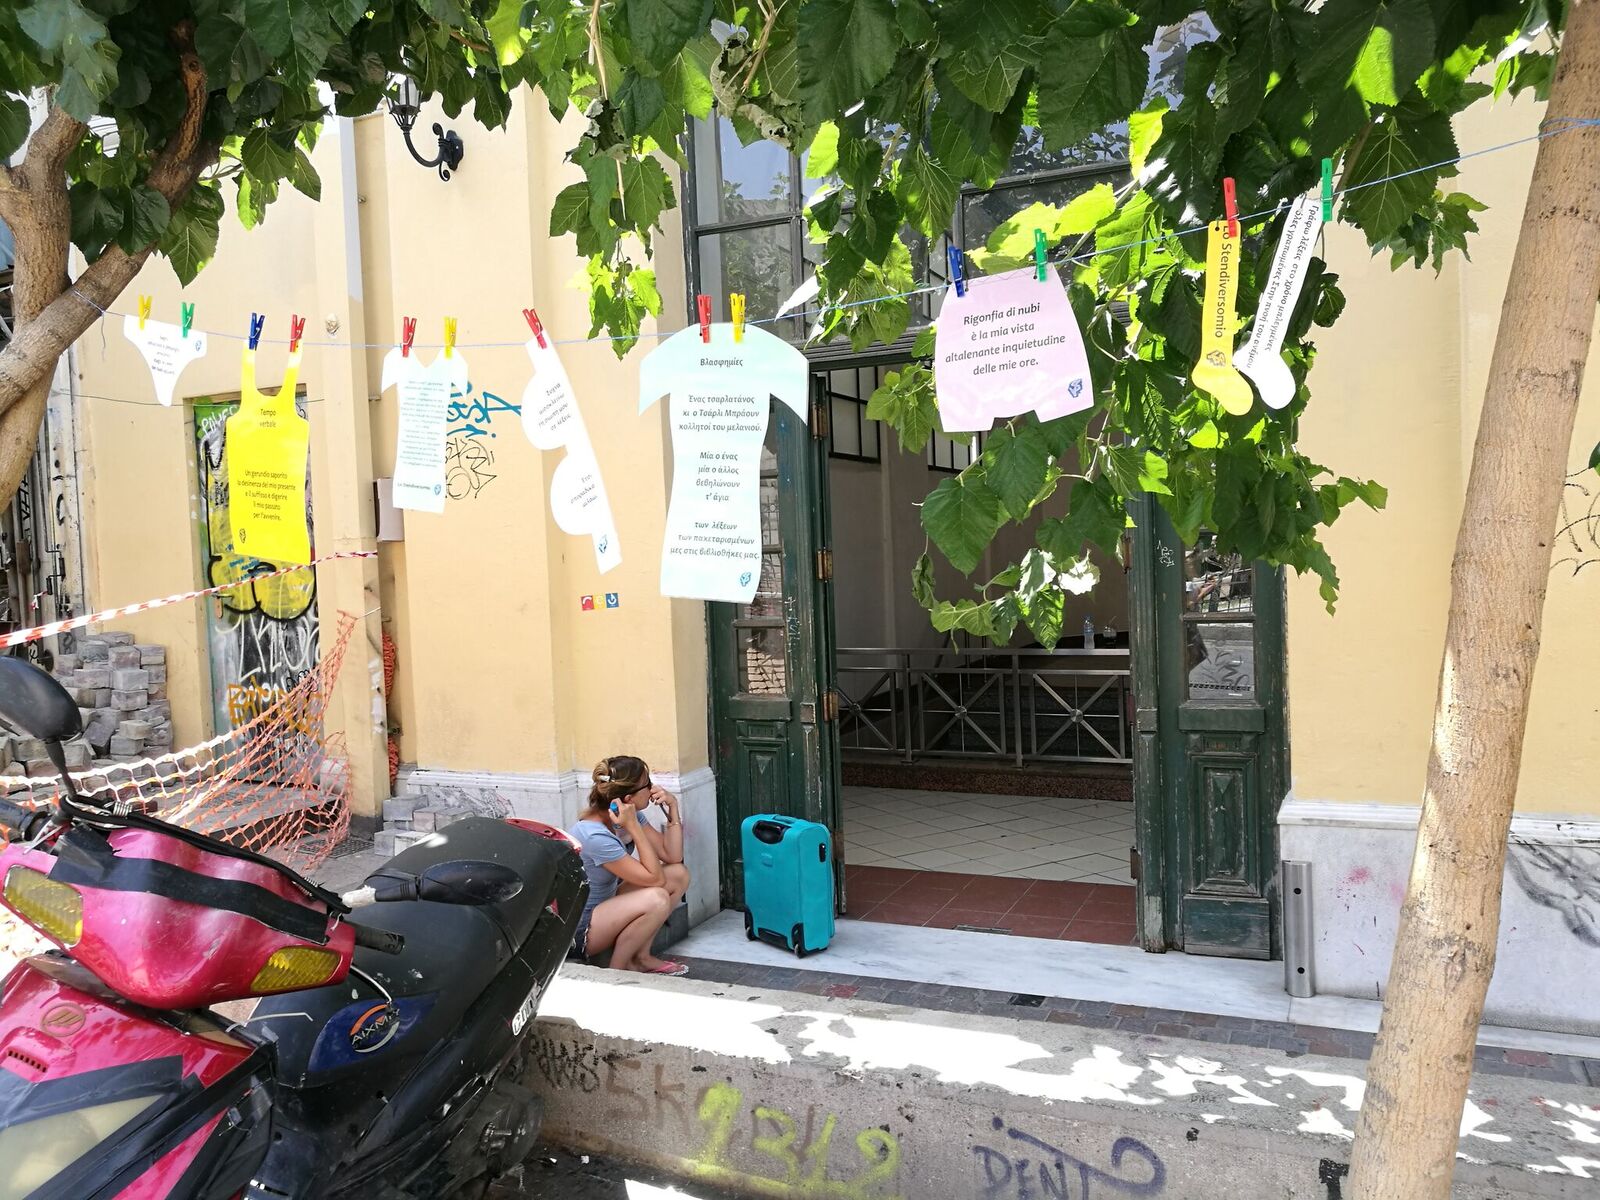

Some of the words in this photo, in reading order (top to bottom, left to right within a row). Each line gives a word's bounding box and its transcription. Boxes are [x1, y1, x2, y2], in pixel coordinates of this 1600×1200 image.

[1304, 204, 1319, 234] Γράφω
[1294, 236, 1310, 261] λέξεις
[1289, 262, 1298, 278] στο
[1215, 243, 1232, 338] Stendiversomio
[1280, 279, 1293, 305] χρόνο
[963, 310, 1004, 326] Rigonfia
[1006, 307, 1016, 315] di
[1017, 302, 1041, 315] nubi
[1260, 301, 1272, 322] πνοή
[971, 331, 978, 341] è
[979, 330, 988, 340] la
[990, 327, 1009, 338] mia
[1010, 322, 1035, 334] vista
[1256, 322, 1265, 338] του
[1265, 304, 1285, 352] μπλεγμένες
[945, 348, 1000, 363] altalenante
[1002, 334, 1066, 354] inquietudine
[1246, 337, 1261, 369] ανέμου
[700, 358, 744, 368] Βλασφημίες
[973, 363, 997, 376] delle
[998, 361, 1017, 372] mie
[1019, 357, 1039, 368] ore.
[688, 394, 706, 404] Ένας
[707, 395, 755, 404] τσαρλατάνος
[260, 408, 277, 417] Tempo
[699, 409, 723, 418] Τσάρλι
[724, 410, 759, 419] Μπράουν
[679, 423, 711, 433] κολλητοί
[727, 423, 762, 433] μελανιού.
[722, 452, 738, 462] ένας
[718, 465, 739, 475] άλλος
[713, 493, 729, 502] άγια
[711, 521, 738, 531] λέξεων
[678, 534, 692, 542] των
[693, 535, 755, 547] πακεταρισμένων
[683, 548, 699, 557] στις
